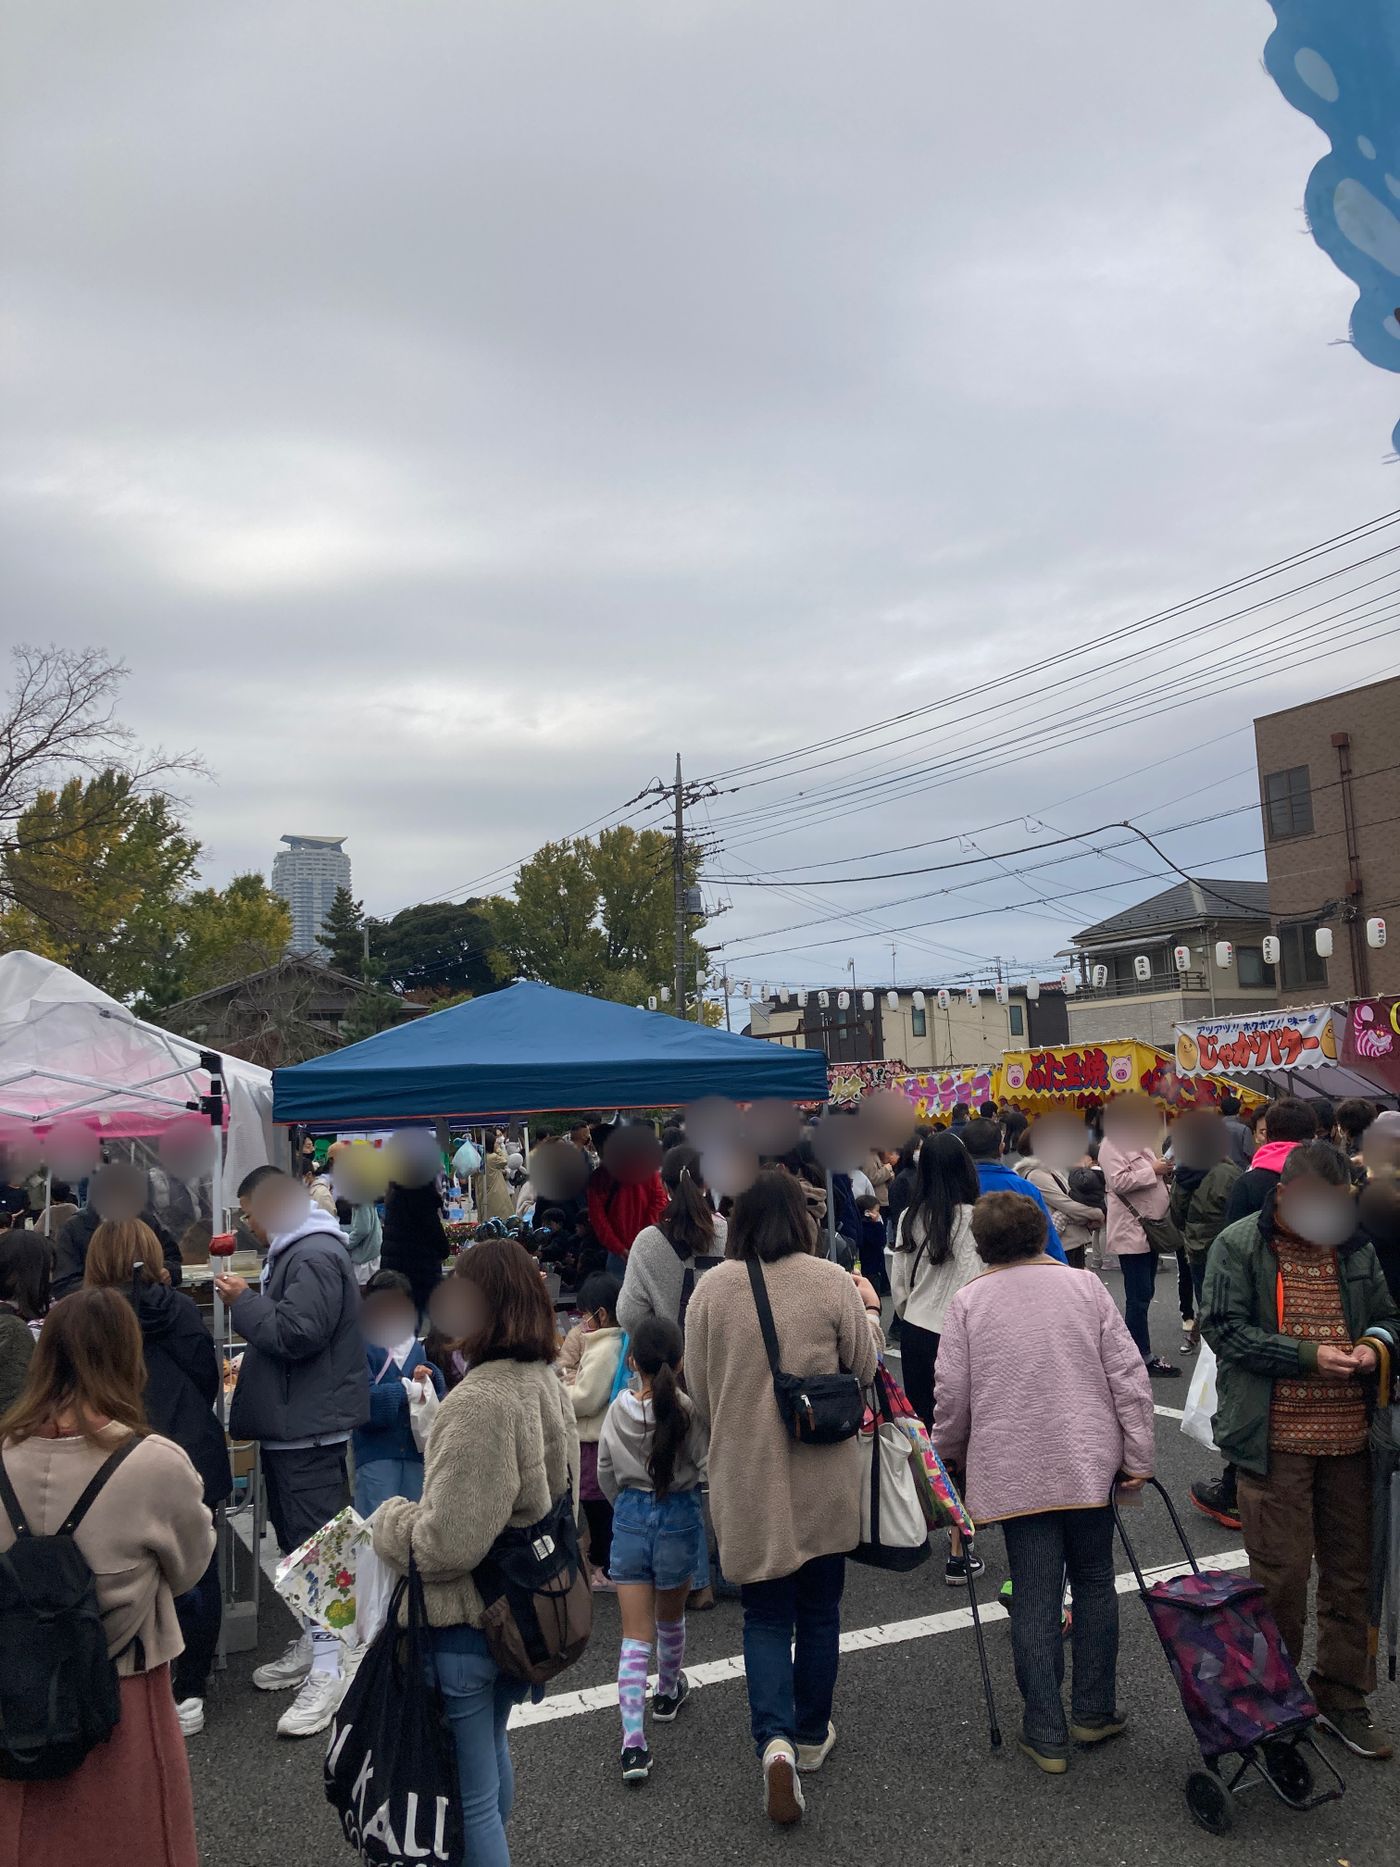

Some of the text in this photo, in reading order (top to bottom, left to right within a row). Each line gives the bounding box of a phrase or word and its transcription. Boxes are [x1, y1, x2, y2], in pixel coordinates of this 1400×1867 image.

[1287, 1014, 1318, 1026] 味一番
[1197, 1026, 1320, 1070] じゃがバター
[1026, 1048, 1110, 1093] ぶた玉焼
